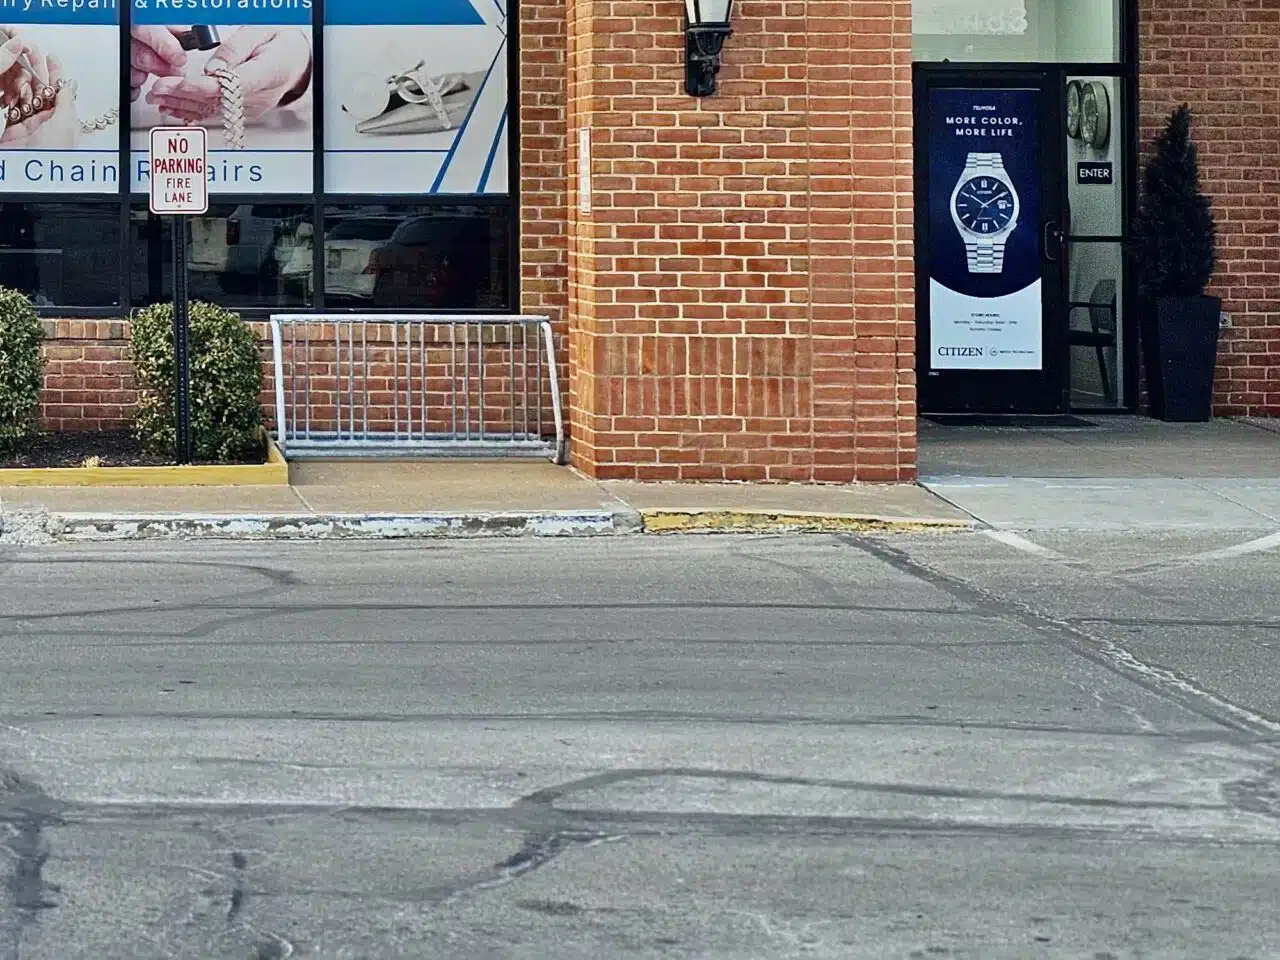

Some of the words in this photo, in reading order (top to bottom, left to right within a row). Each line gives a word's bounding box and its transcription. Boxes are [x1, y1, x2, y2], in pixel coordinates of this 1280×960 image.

[946, 116, 977, 125] MORE
[981, 117, 1023, 126] COLOR,
[955, 128, 986, 136] MORE
[167, 138, 188, 154] NO
[24, 158, 117, 182] Chain
[137, 159, 262, 183] Rairs
[154, 158, 202, 174] PARKING
[1080, 168, 1110, 178] ENTER
[166, 178, 191, 188] FIRE
[165, 192, 192, 203] LANE
[937, 346, 984, 357] CITIZEN
